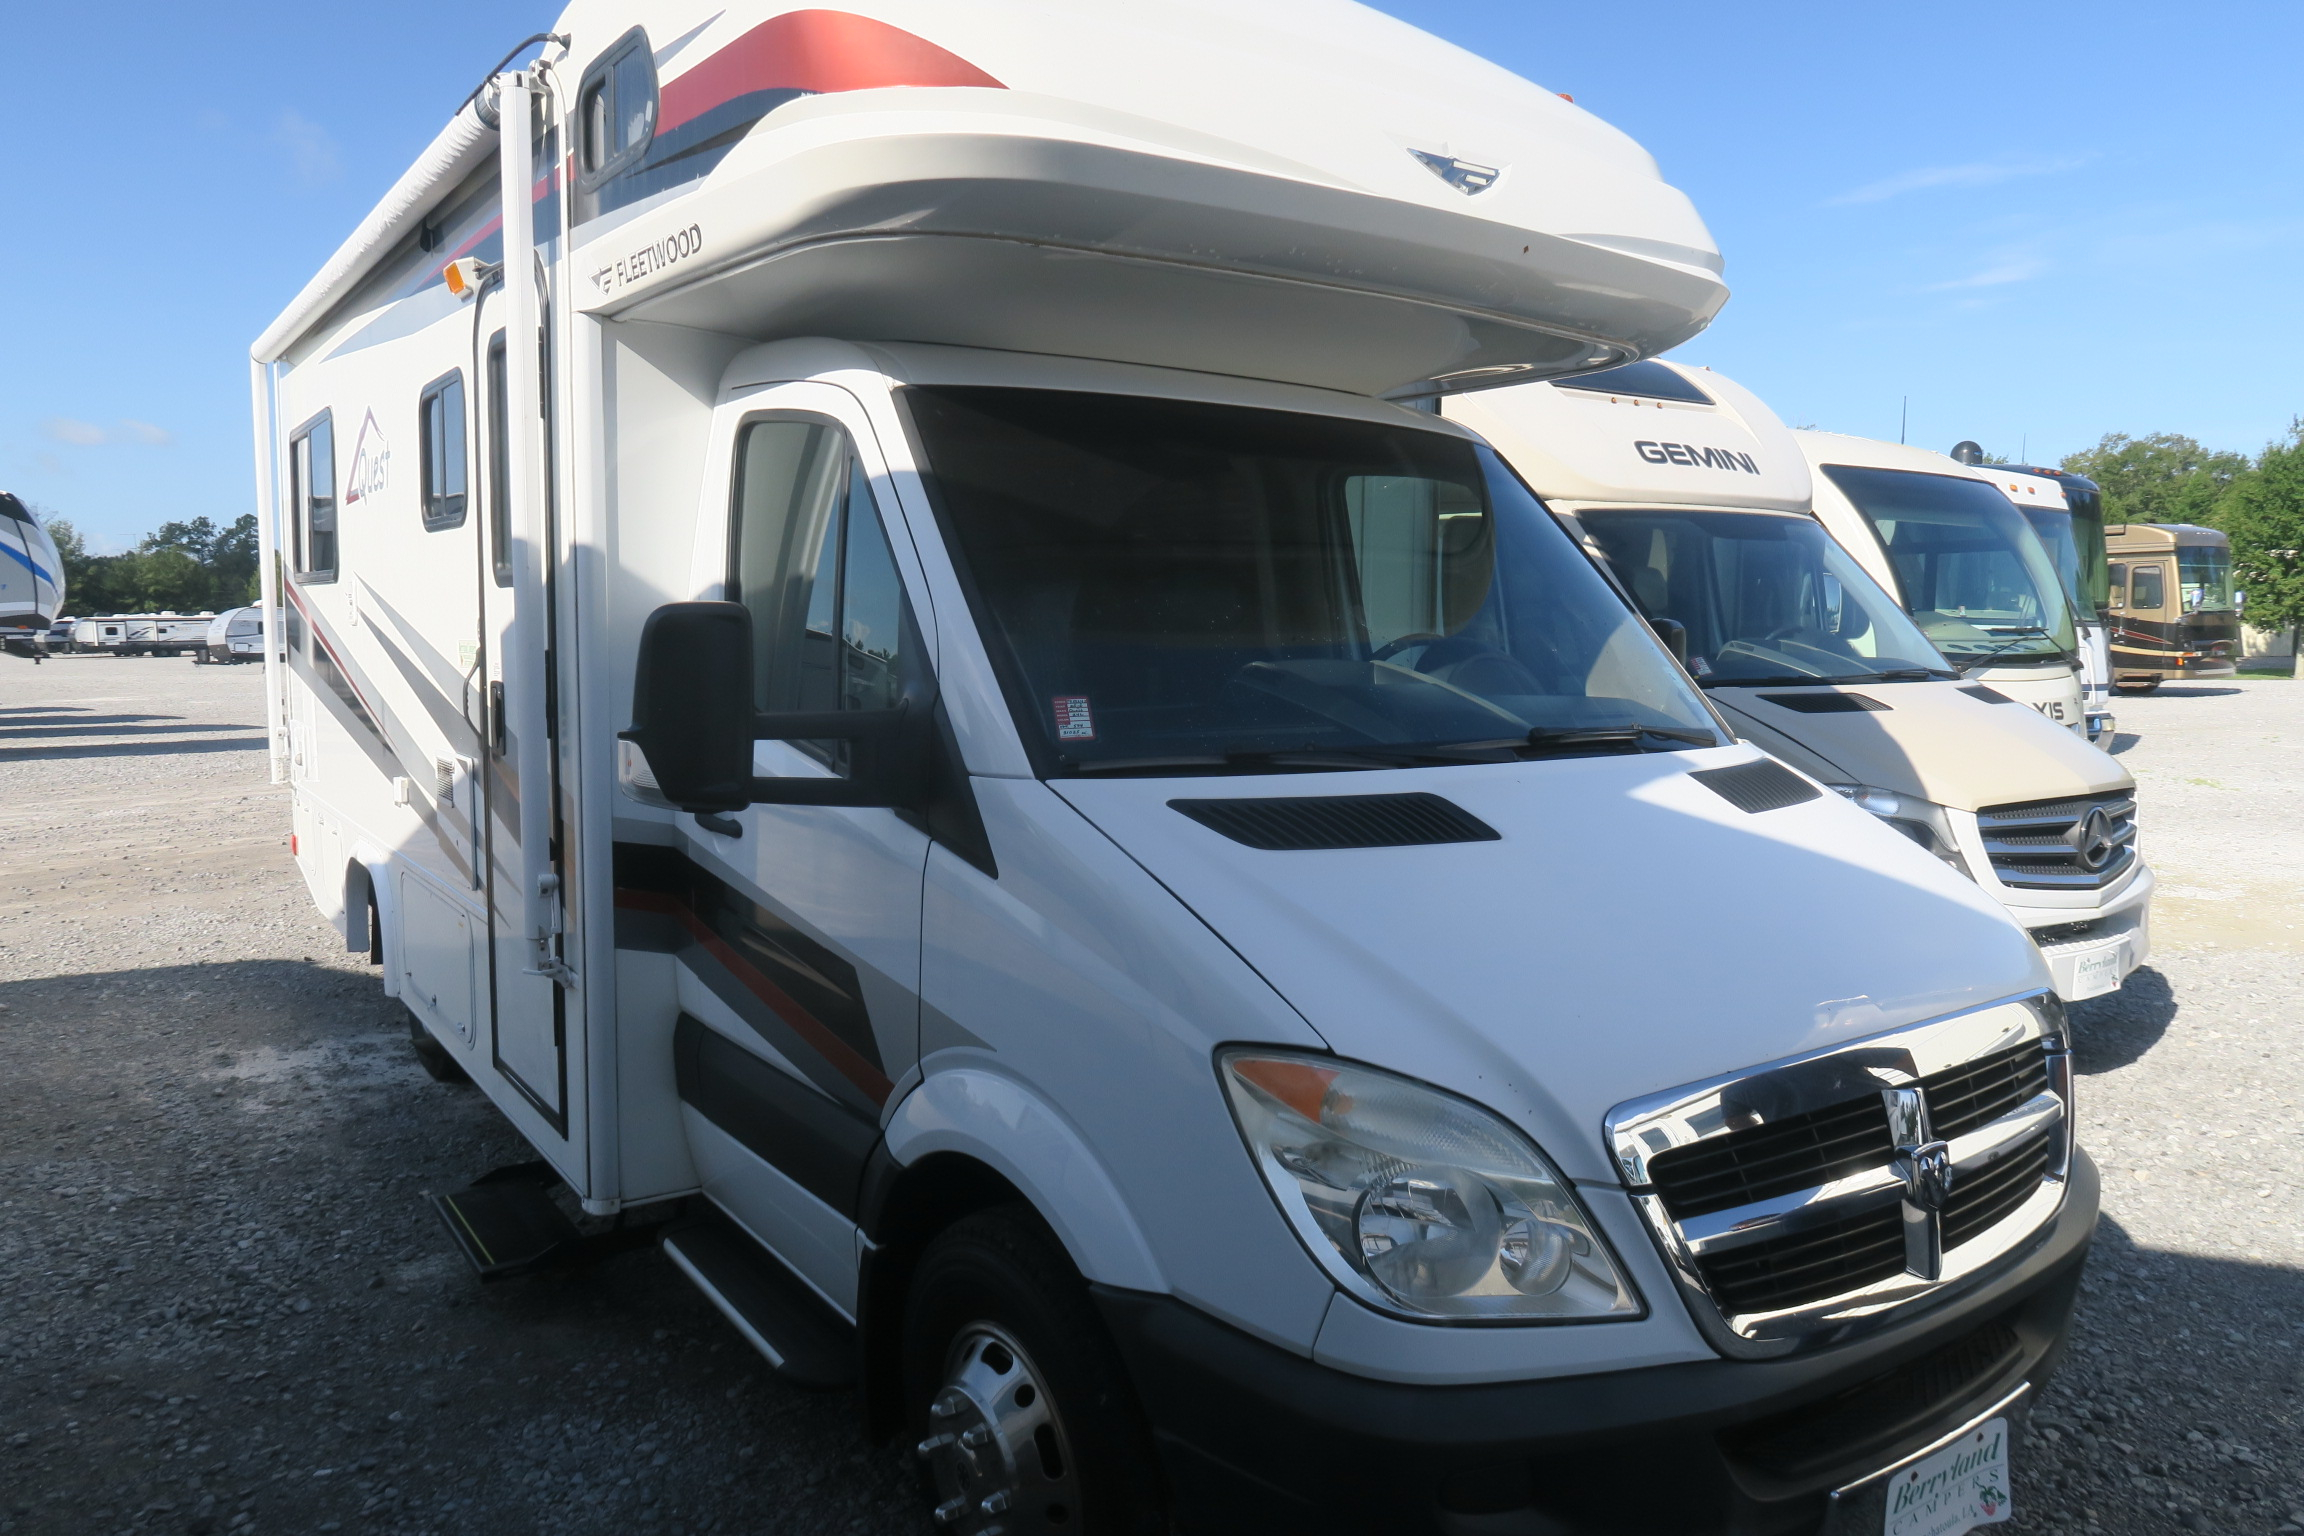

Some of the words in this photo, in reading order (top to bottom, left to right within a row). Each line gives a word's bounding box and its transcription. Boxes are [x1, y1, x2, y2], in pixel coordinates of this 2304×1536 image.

[616, 222, 703, 287] FLEETWOOD
[358, 440, 391, 506] Quest
[1633, 440, 1761, 475] GEMINI
[2031, 701, 2064, 720] XIS
[1893, 1432, 2000, 1514] Berryland
[1893, 1468, 1999, 1536] CAMPERS
